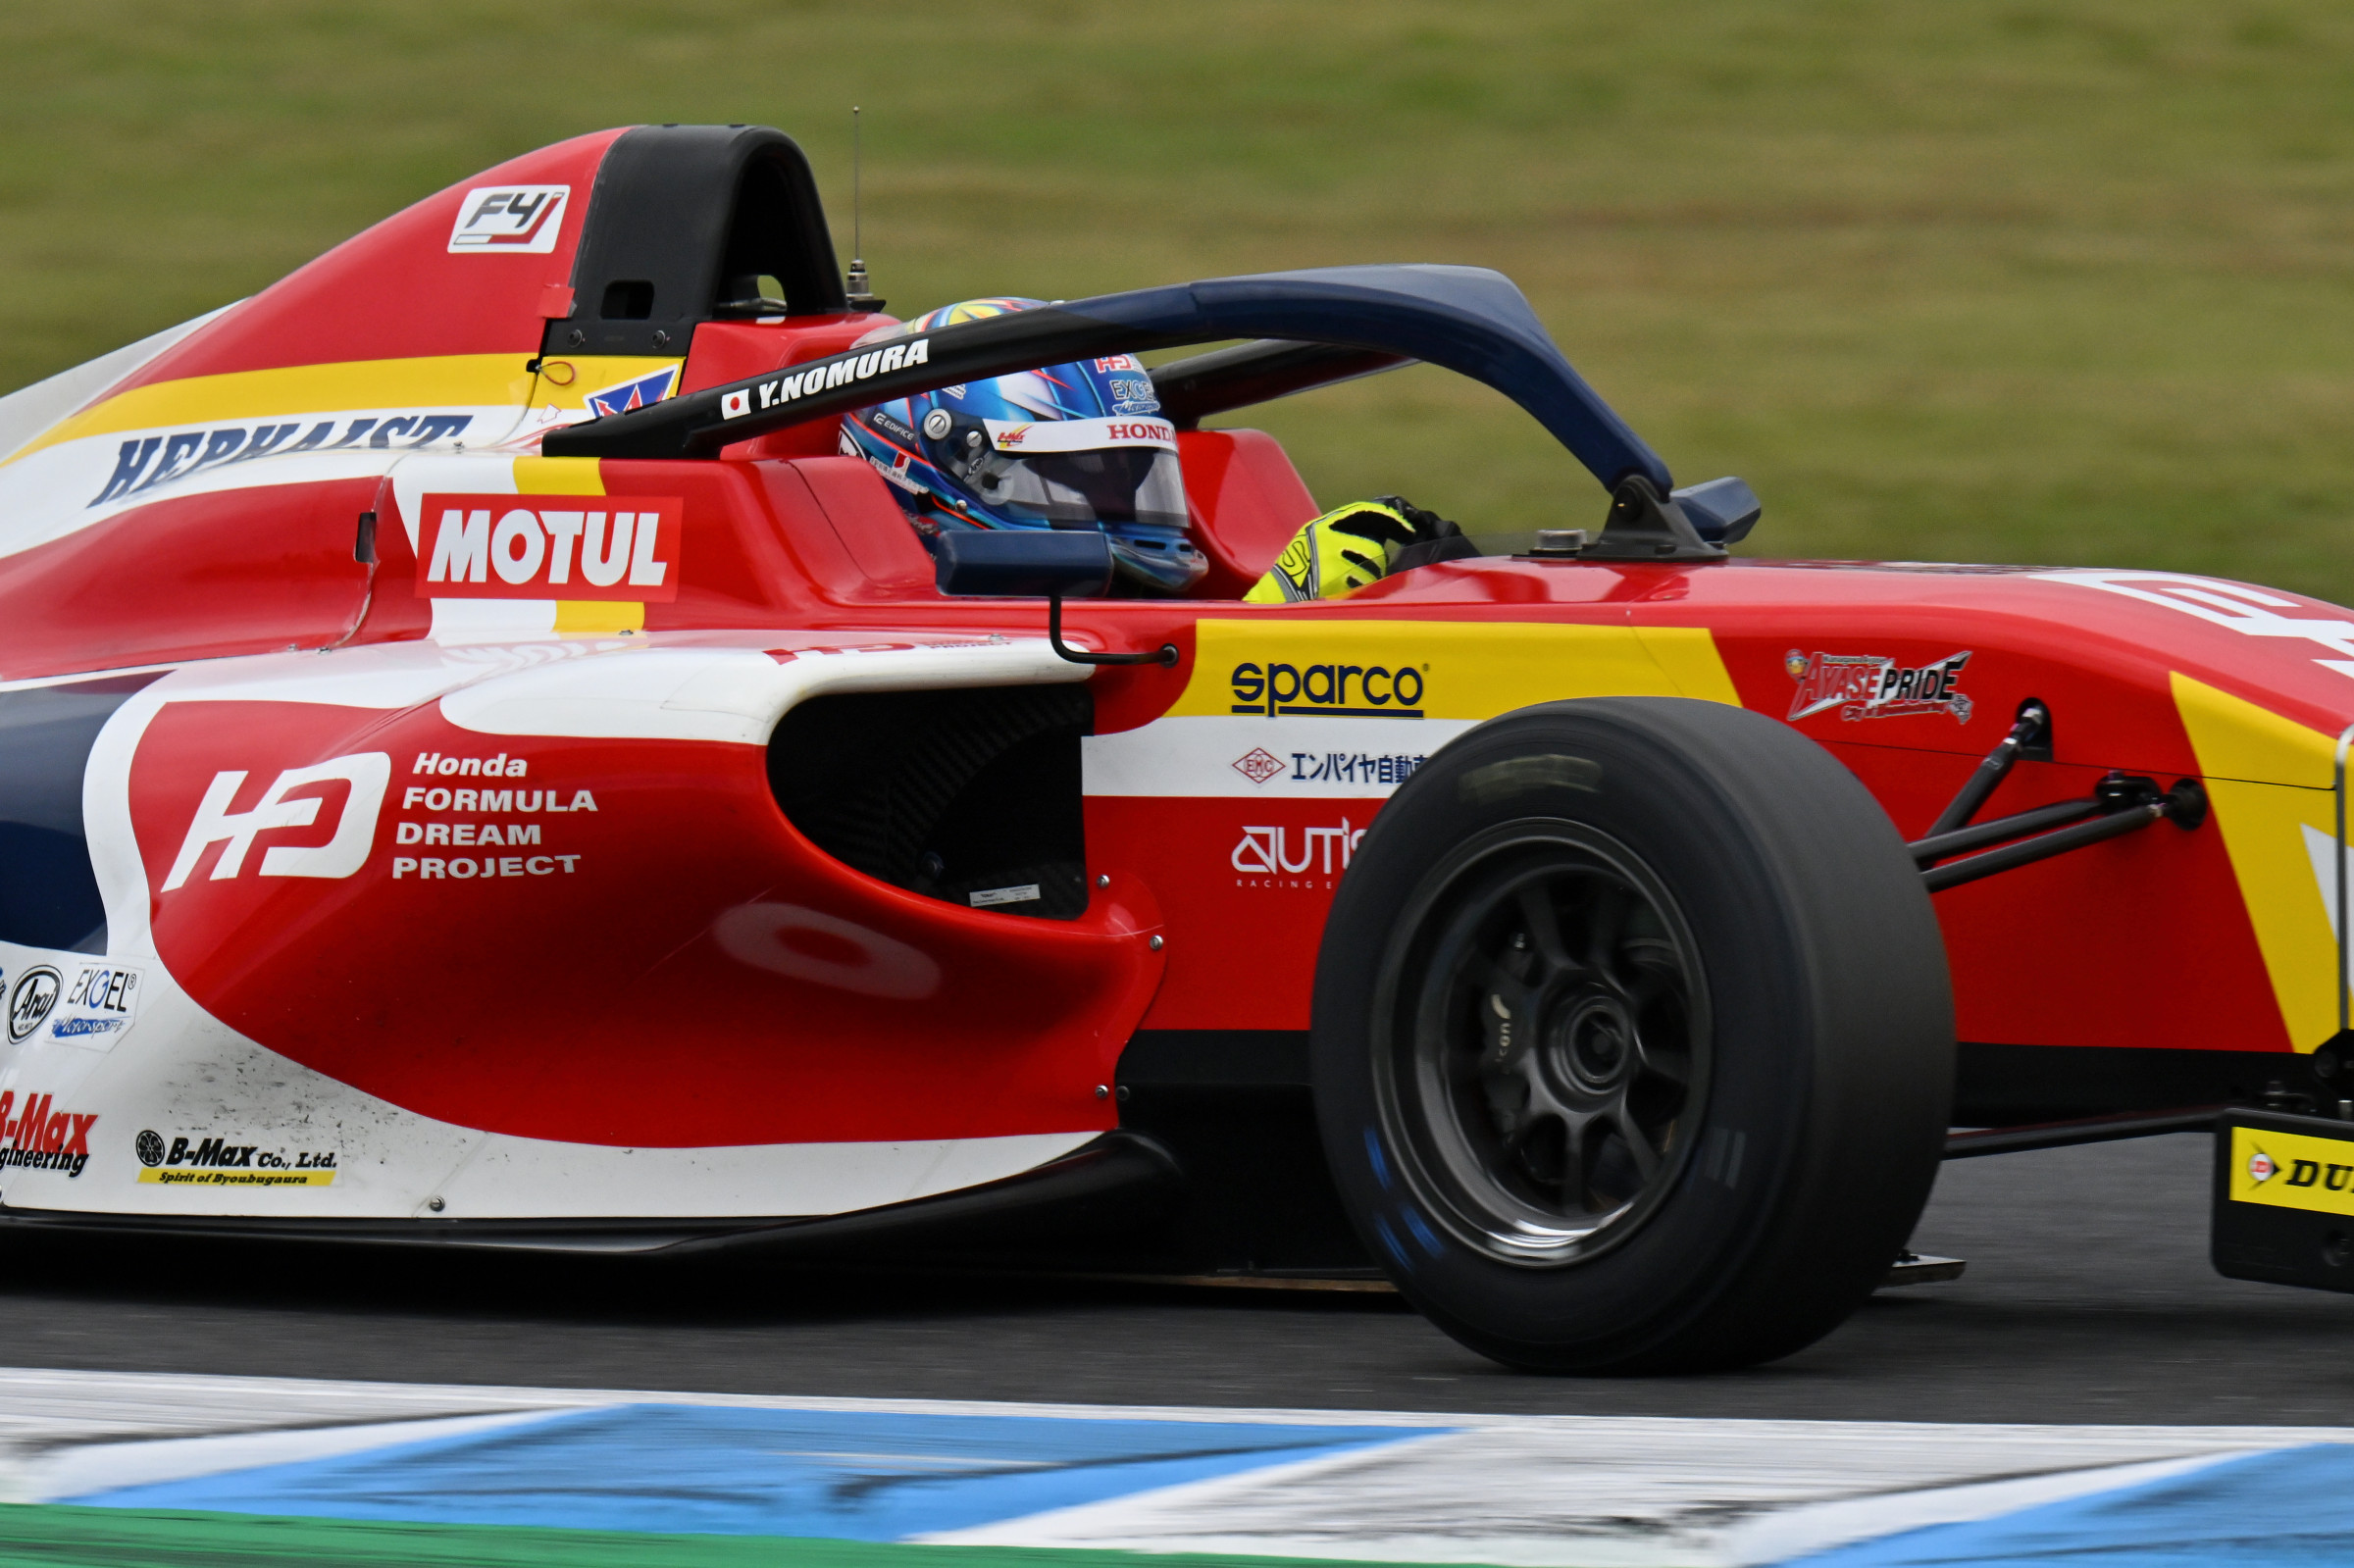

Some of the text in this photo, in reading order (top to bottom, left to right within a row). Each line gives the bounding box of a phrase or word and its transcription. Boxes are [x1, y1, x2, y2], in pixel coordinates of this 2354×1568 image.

[759, 339, 929, 409] Y.NOMURA
[884, 419, 914, 441] EDIFICE
[427, 509, 667, 586] MOTUL
[1879, 651, 1972, 700] PRIDE
[1232, 663, 1424, 718] sparco
[413, 753, 528, 777] Honda
[402, 787, 598, 812] FORMULA
[395, 822, 541, 846] DREAM
[392, 855, 582, 879] PROJECT
[1236, 880, 1312, 888] RACING
[68, 969, 127, 1012] EXGEL
[166, 1138, 258, 1167] B-Max
[295, 1152, 337, 1168] Ltd.
[159, 1172, 195, 1183] Spirit
[197, 1173, 210, 1184] of
[2284, 1159, 2354, 1193] DU
